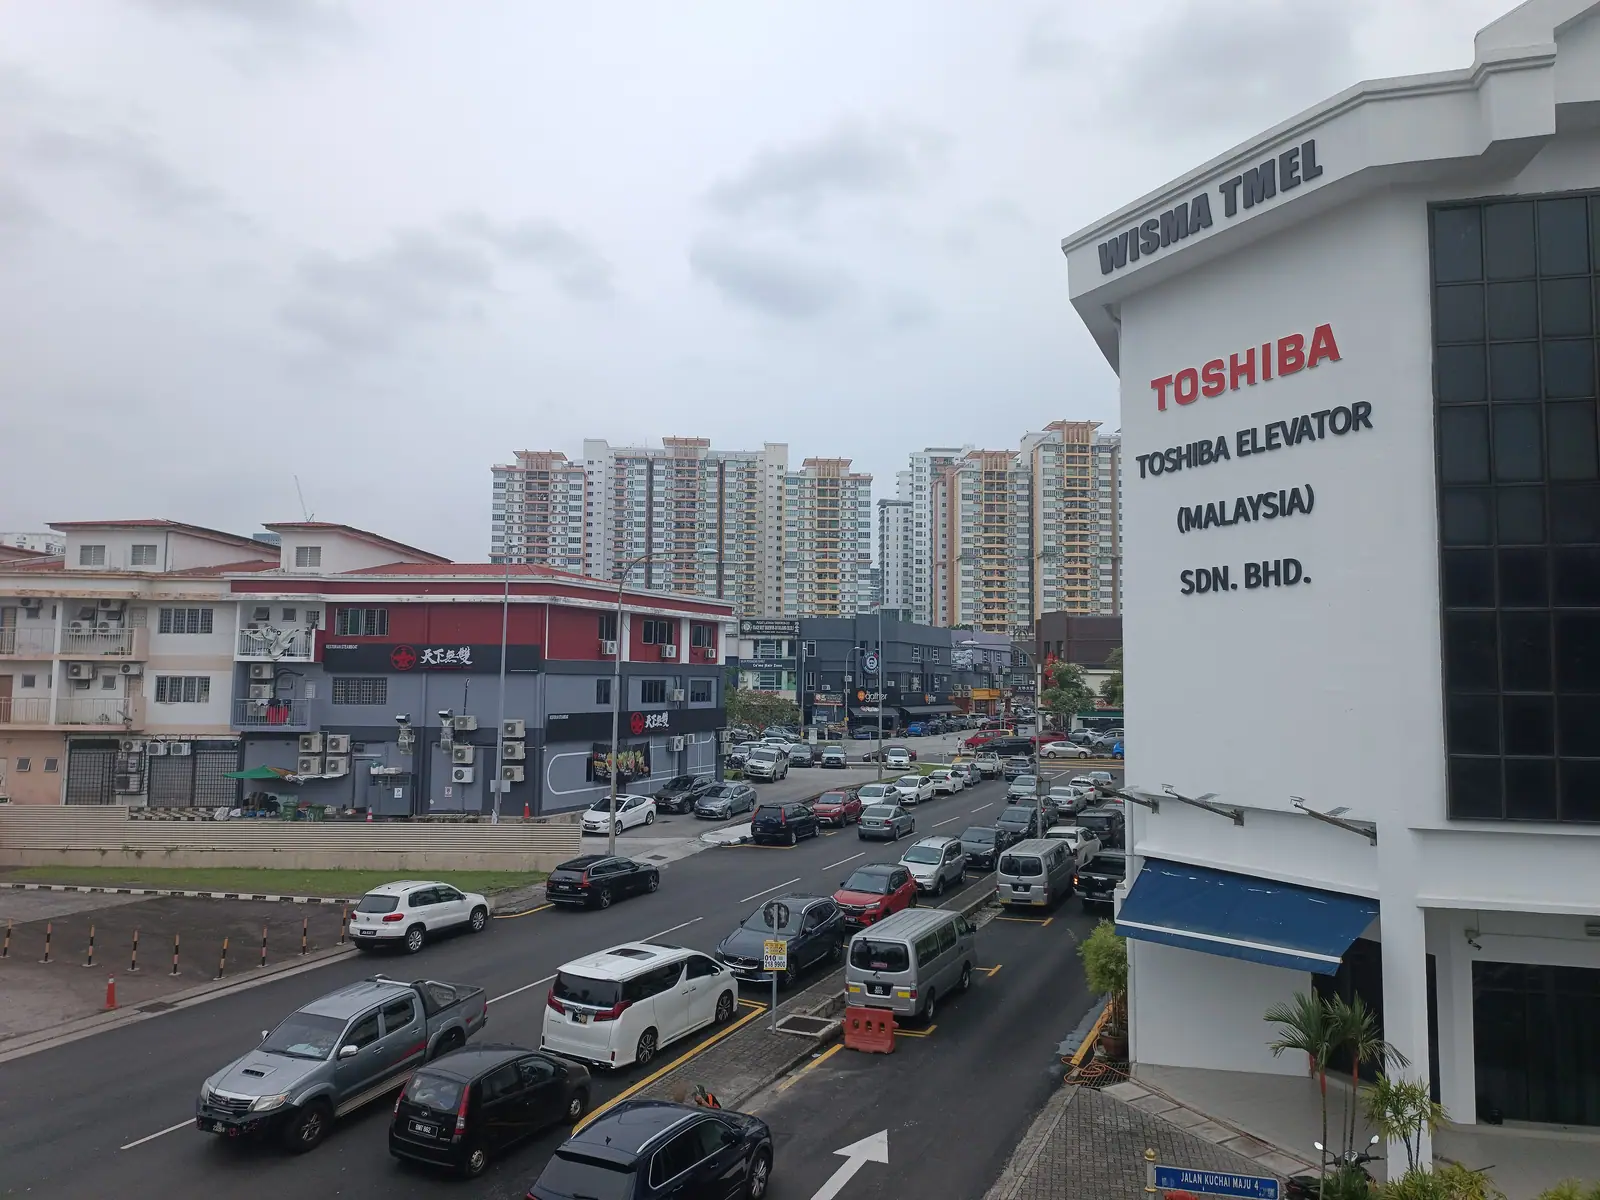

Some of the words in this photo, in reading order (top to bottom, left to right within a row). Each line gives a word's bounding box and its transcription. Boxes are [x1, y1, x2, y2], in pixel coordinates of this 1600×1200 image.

[1098, 192, 1213, 275] WISMA
[1219, 139, 1323, 217] TMEL
[1150, 323, 1343, 411] TOSHIBA
[1136, 435, 1231, 479] TOSHIBA
[1236, 400, 1373, 457] ELEVATOR
[1177, 483, 1315, 534] (MALAYSIA)
[1180, 565, 1238, 595] SDN.
[1244, 558, 1312, 589] BHD.
[1181, 1172, 1202, 1184] JALAN
[1204, 1175, 1230, 1187] KUCHAI
[1232, 1179, 1251, 1190] MAJU
[1254, 1180, 1259, 1190] 4
